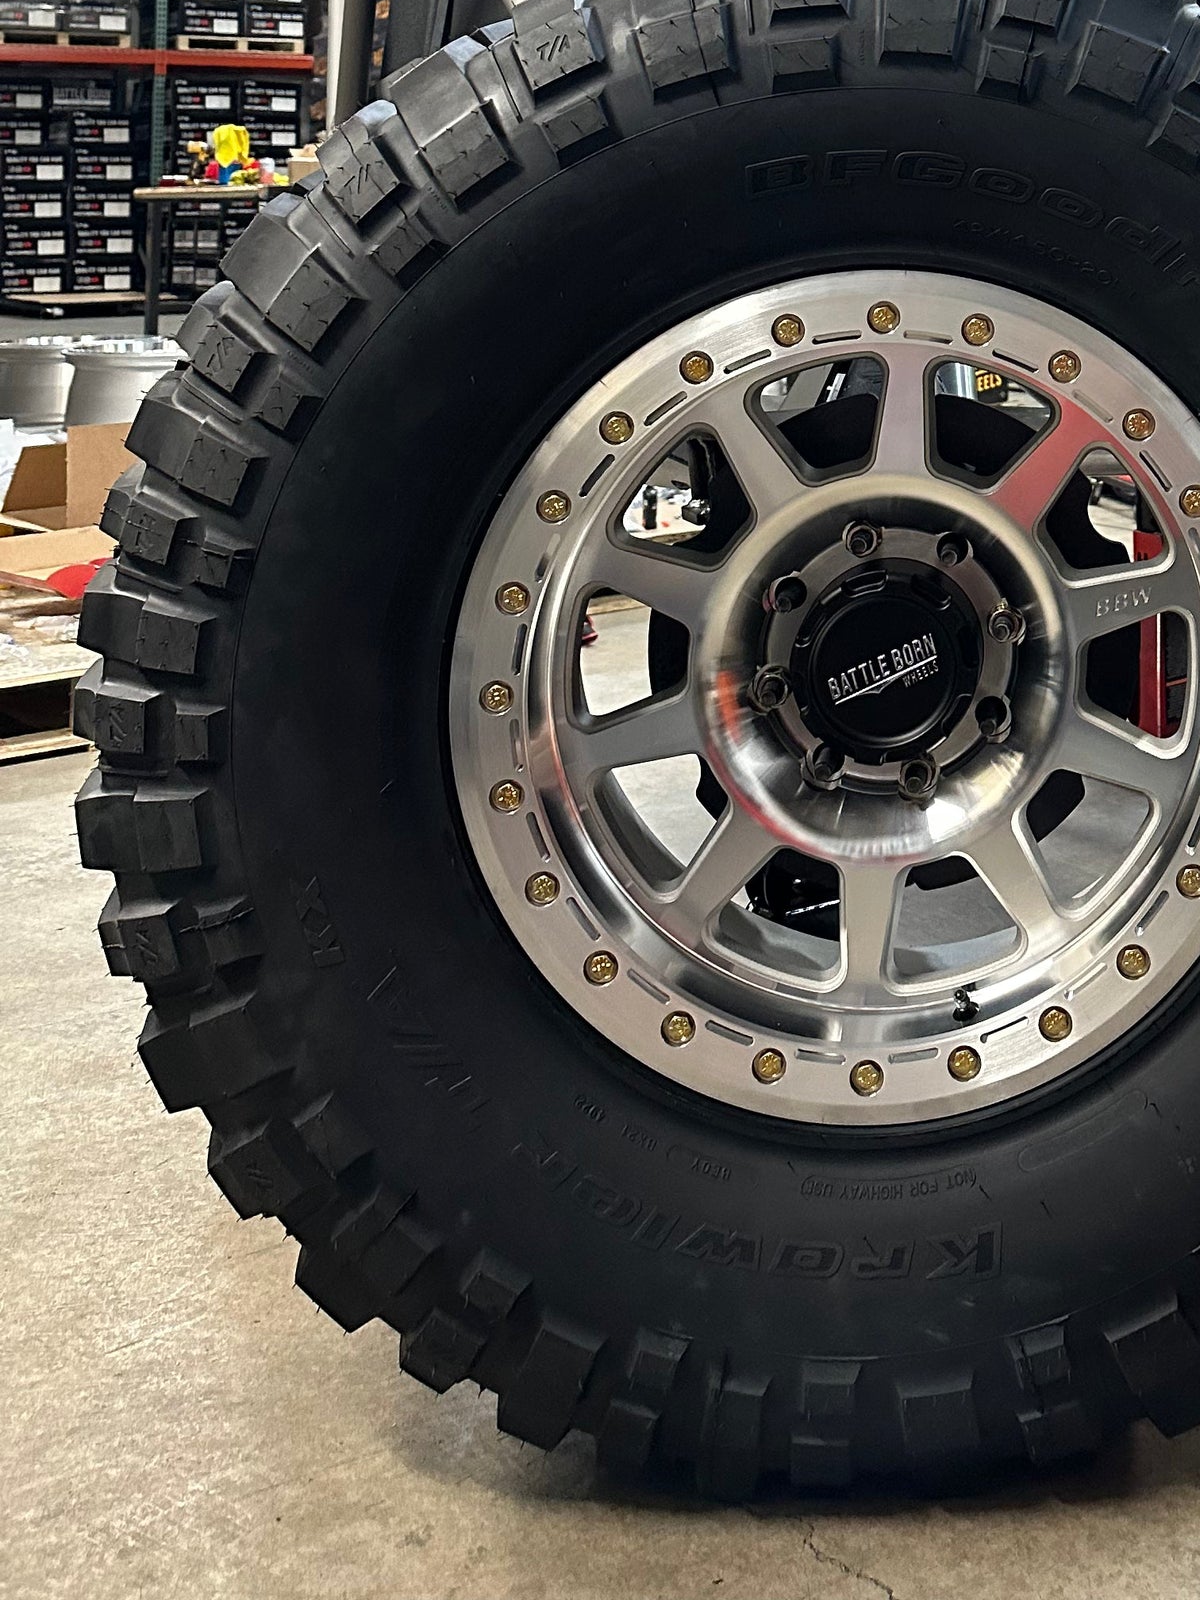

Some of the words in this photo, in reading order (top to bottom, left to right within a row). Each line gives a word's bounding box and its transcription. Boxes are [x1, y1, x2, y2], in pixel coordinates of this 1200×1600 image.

[1095, 586, 1153, 618] BBW
[828, 653, 891, 700] BATTLE
[891, 633, 937, 671] BORN
[902, 660, 939, 688] WHEELS
